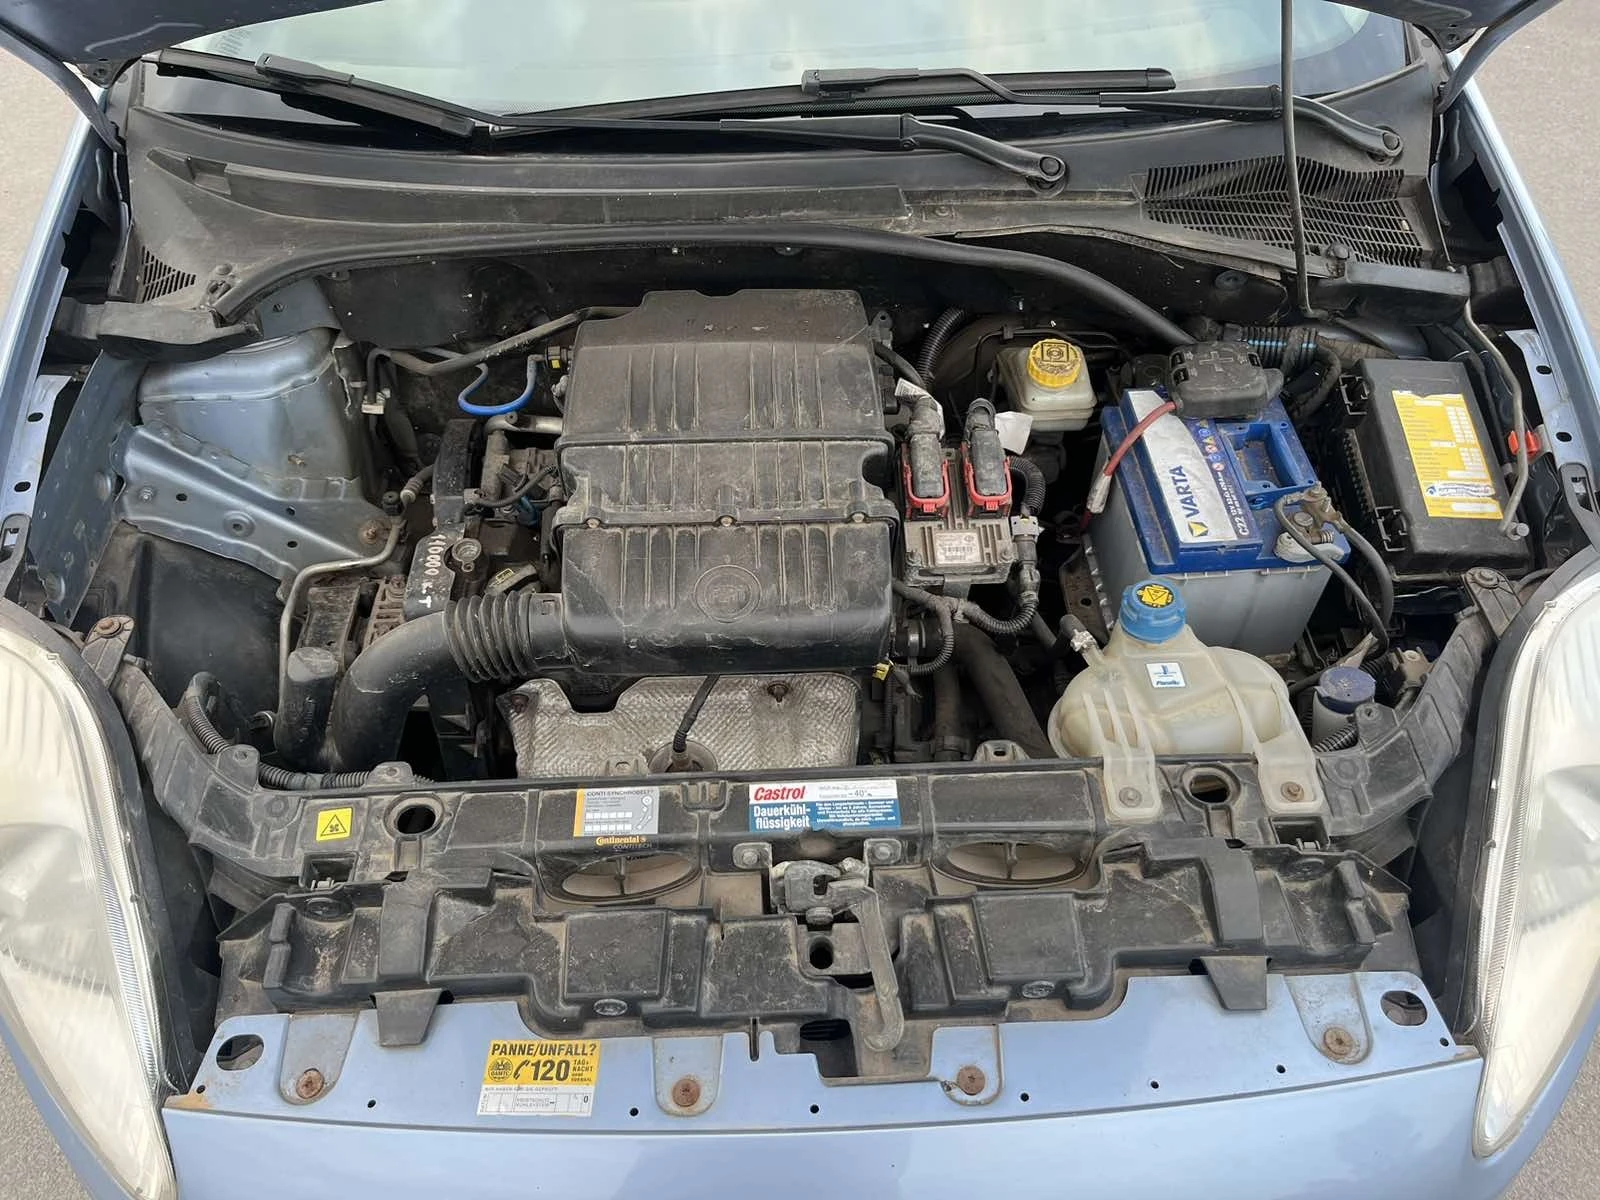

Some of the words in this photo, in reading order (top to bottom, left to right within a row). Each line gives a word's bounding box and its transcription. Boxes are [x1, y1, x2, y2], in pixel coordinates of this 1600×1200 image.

[1168, 464, 1201, 519] VARTA
[1235, 517, 1250, 535] C22
[754, 786, 806, 801] Castrol
[753, 804, 811, 817] Dauerkühl-
[755, 815, 810, 830] flüssigkeit
[595, 835, 640, 846] Continental
[491, 1043, 597, 1057] PANNE/UNFALL?
[531, 1059, 571, 1082] 120
